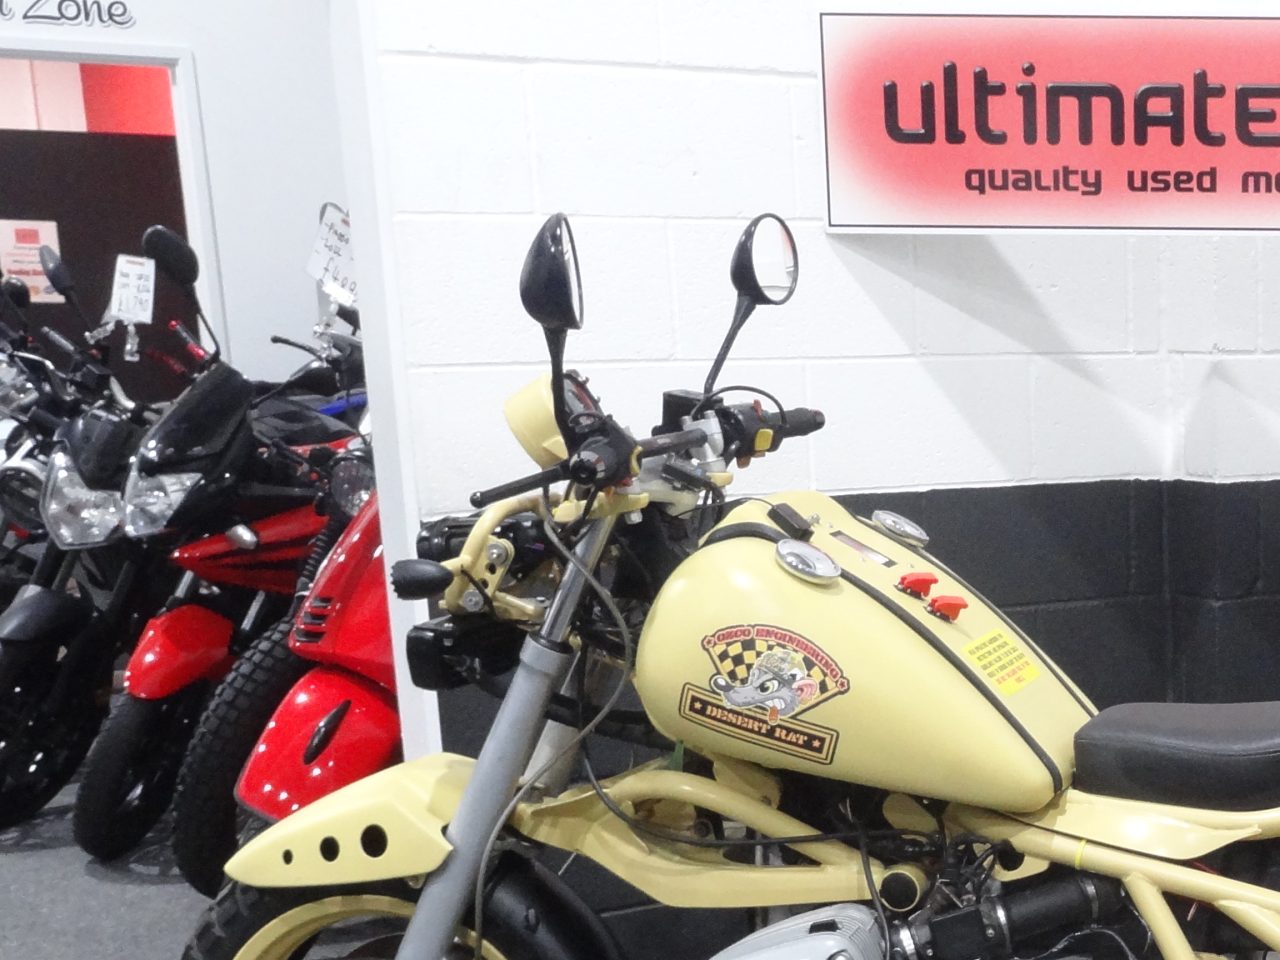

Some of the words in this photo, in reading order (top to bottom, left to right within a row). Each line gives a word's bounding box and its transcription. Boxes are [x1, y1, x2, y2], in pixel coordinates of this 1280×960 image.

[22, 0, 135, 26] Zone
[964, 166, 1102, 196] quality
[1127, 167, 1217, 193] used
[706, 705, 770, 733] DESERT
[774, 728, 808, 745] RAT
